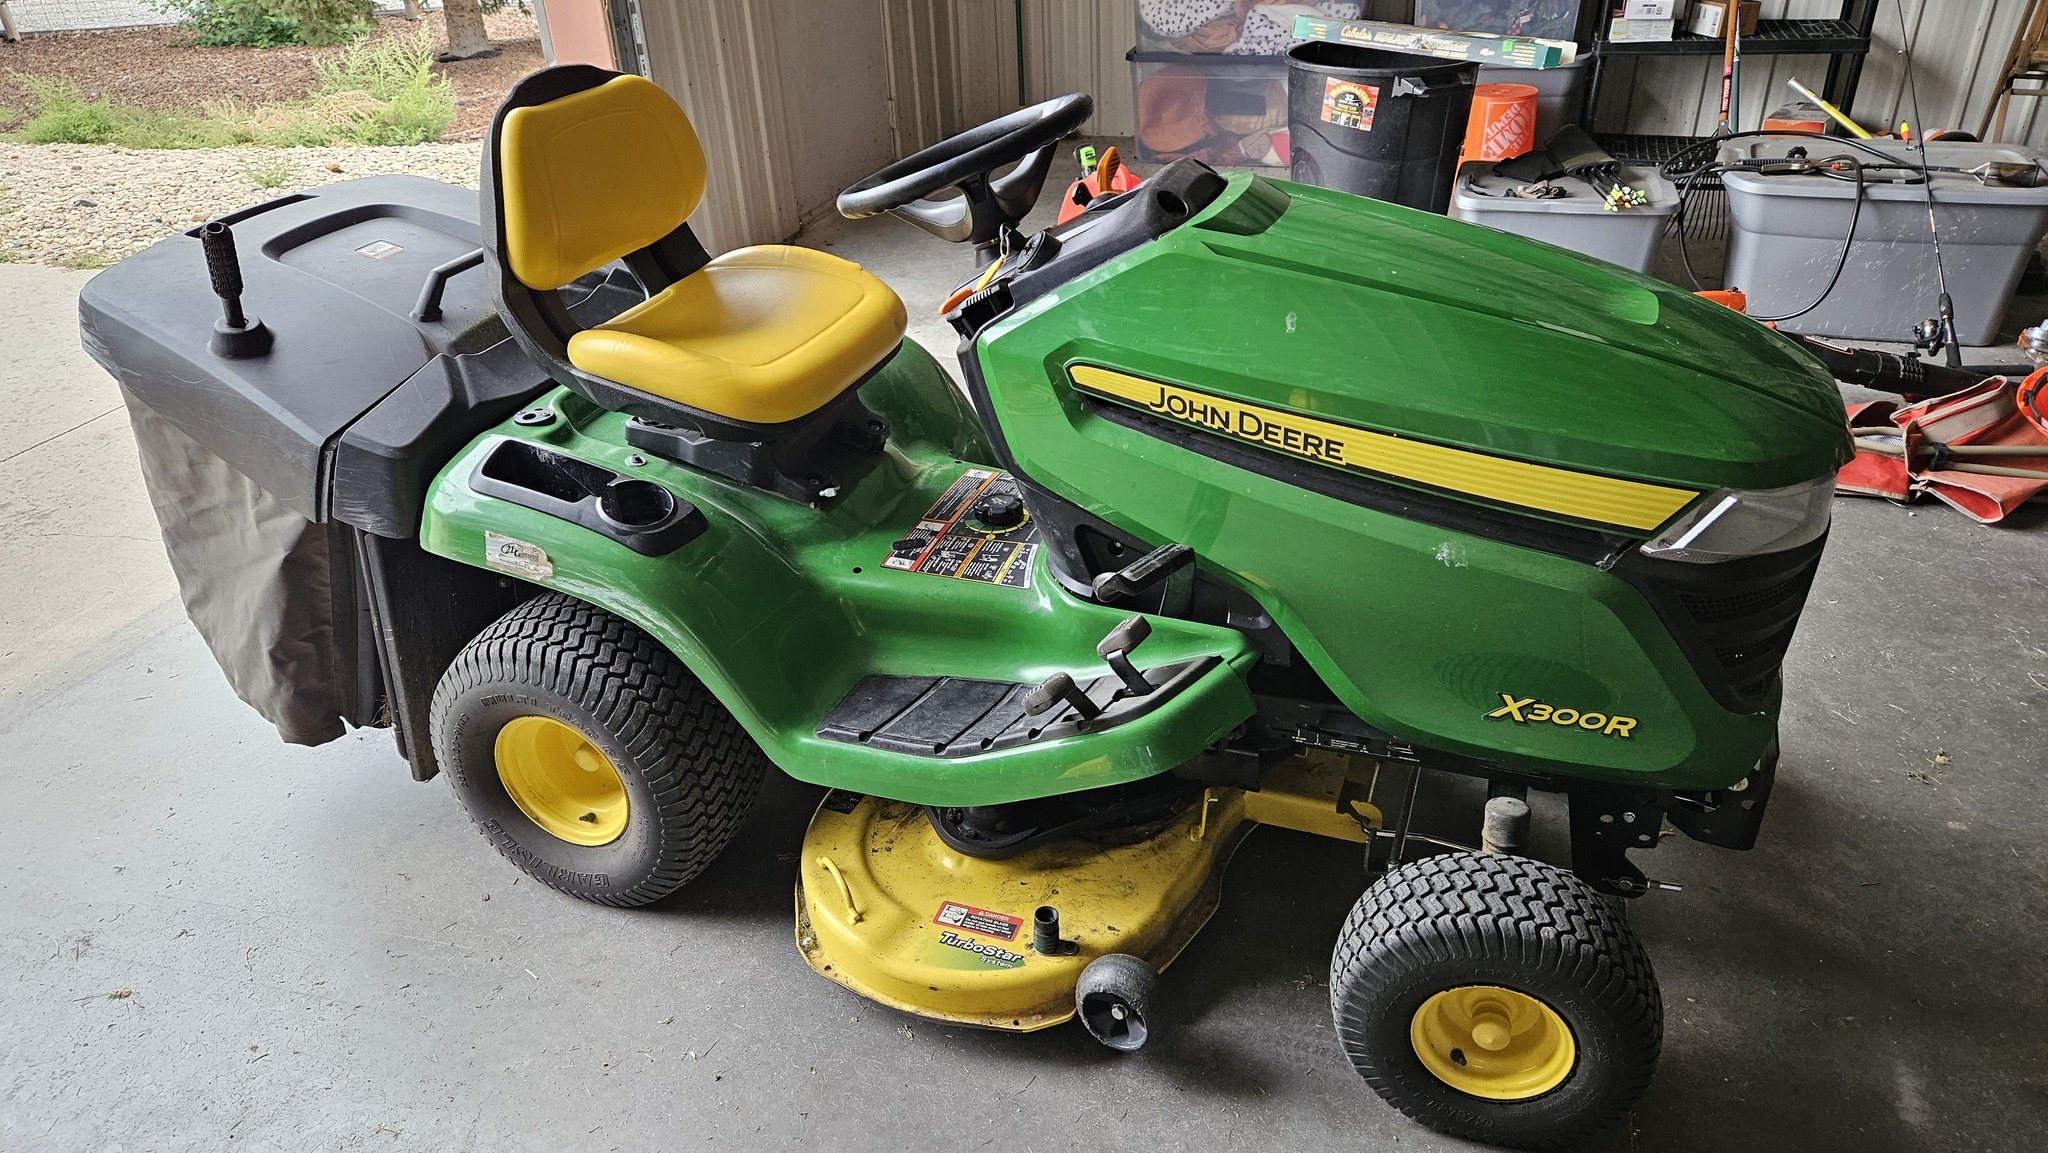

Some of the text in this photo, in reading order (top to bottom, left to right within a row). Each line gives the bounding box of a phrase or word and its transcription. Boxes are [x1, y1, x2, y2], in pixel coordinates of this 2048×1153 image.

[1340, 24, 1372, 41] Cabela's
[1344, 93, 1355, 102] 32
[1483, 107, 1531, 159] HOME
[1486, 103, 1521, 139] DEPOT
[1149, 387, 1345, 462] JOHN DEERE
[1487, 692, 1638, 738] X300R
[481, 818, 610, 888] CARLISLE
[984, 911, 1010, 922] DANGER
[939, 931, 1024, 962] TurboStar
[980, 955, 1013, 969] System
